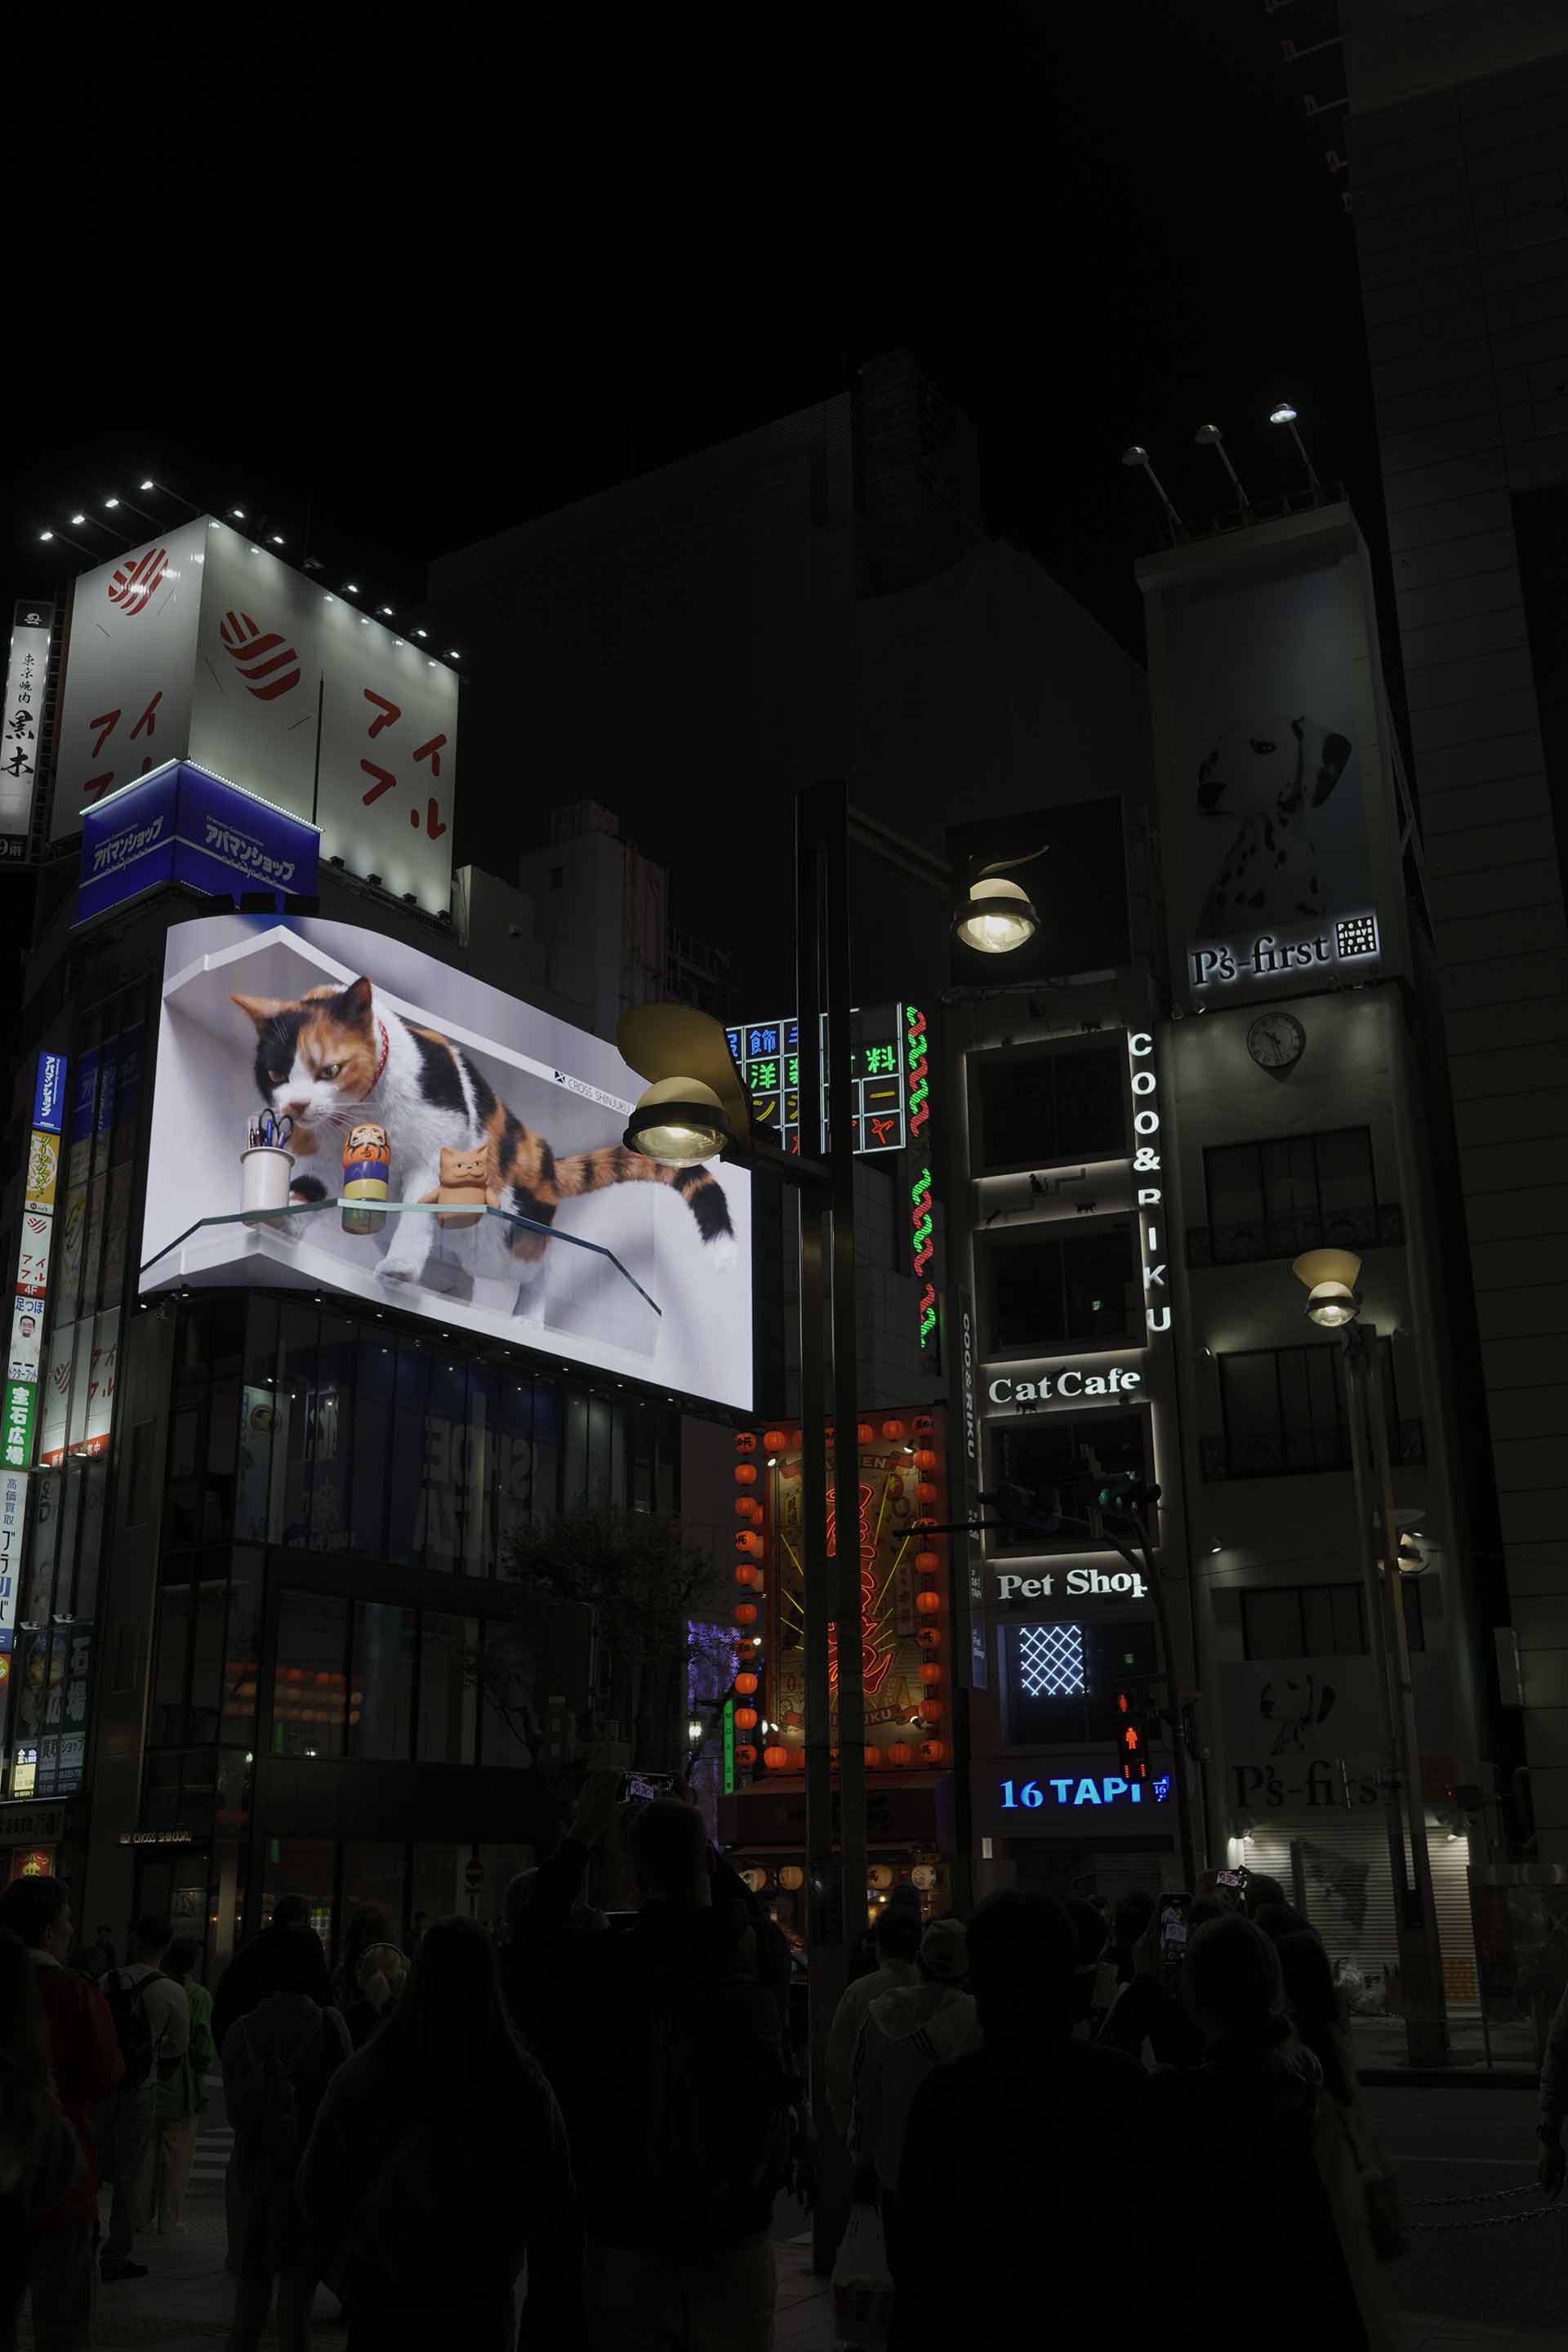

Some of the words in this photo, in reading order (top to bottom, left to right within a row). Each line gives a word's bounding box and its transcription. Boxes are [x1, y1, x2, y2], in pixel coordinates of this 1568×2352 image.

[1, 710, 35, 777] 黒木
[93, 816, 164, 872] アパマンショップ
[205, 823, 296, 881] アパマンショップ
[568, 1078, 592, 1098] CROSS
[24, 1285, 38, 1295] 4F
[988, 1376, 1053, 1404] Cat
[1057, 1367, 1142, 1397] Cafe
[6, 1387, 30, 1465] 宝石広場
[3, 1478, 18, 1526] 高価買取
[996, 1574, 1056, 1600] Pet
[1000, 1778, 1044, 1810] 16
